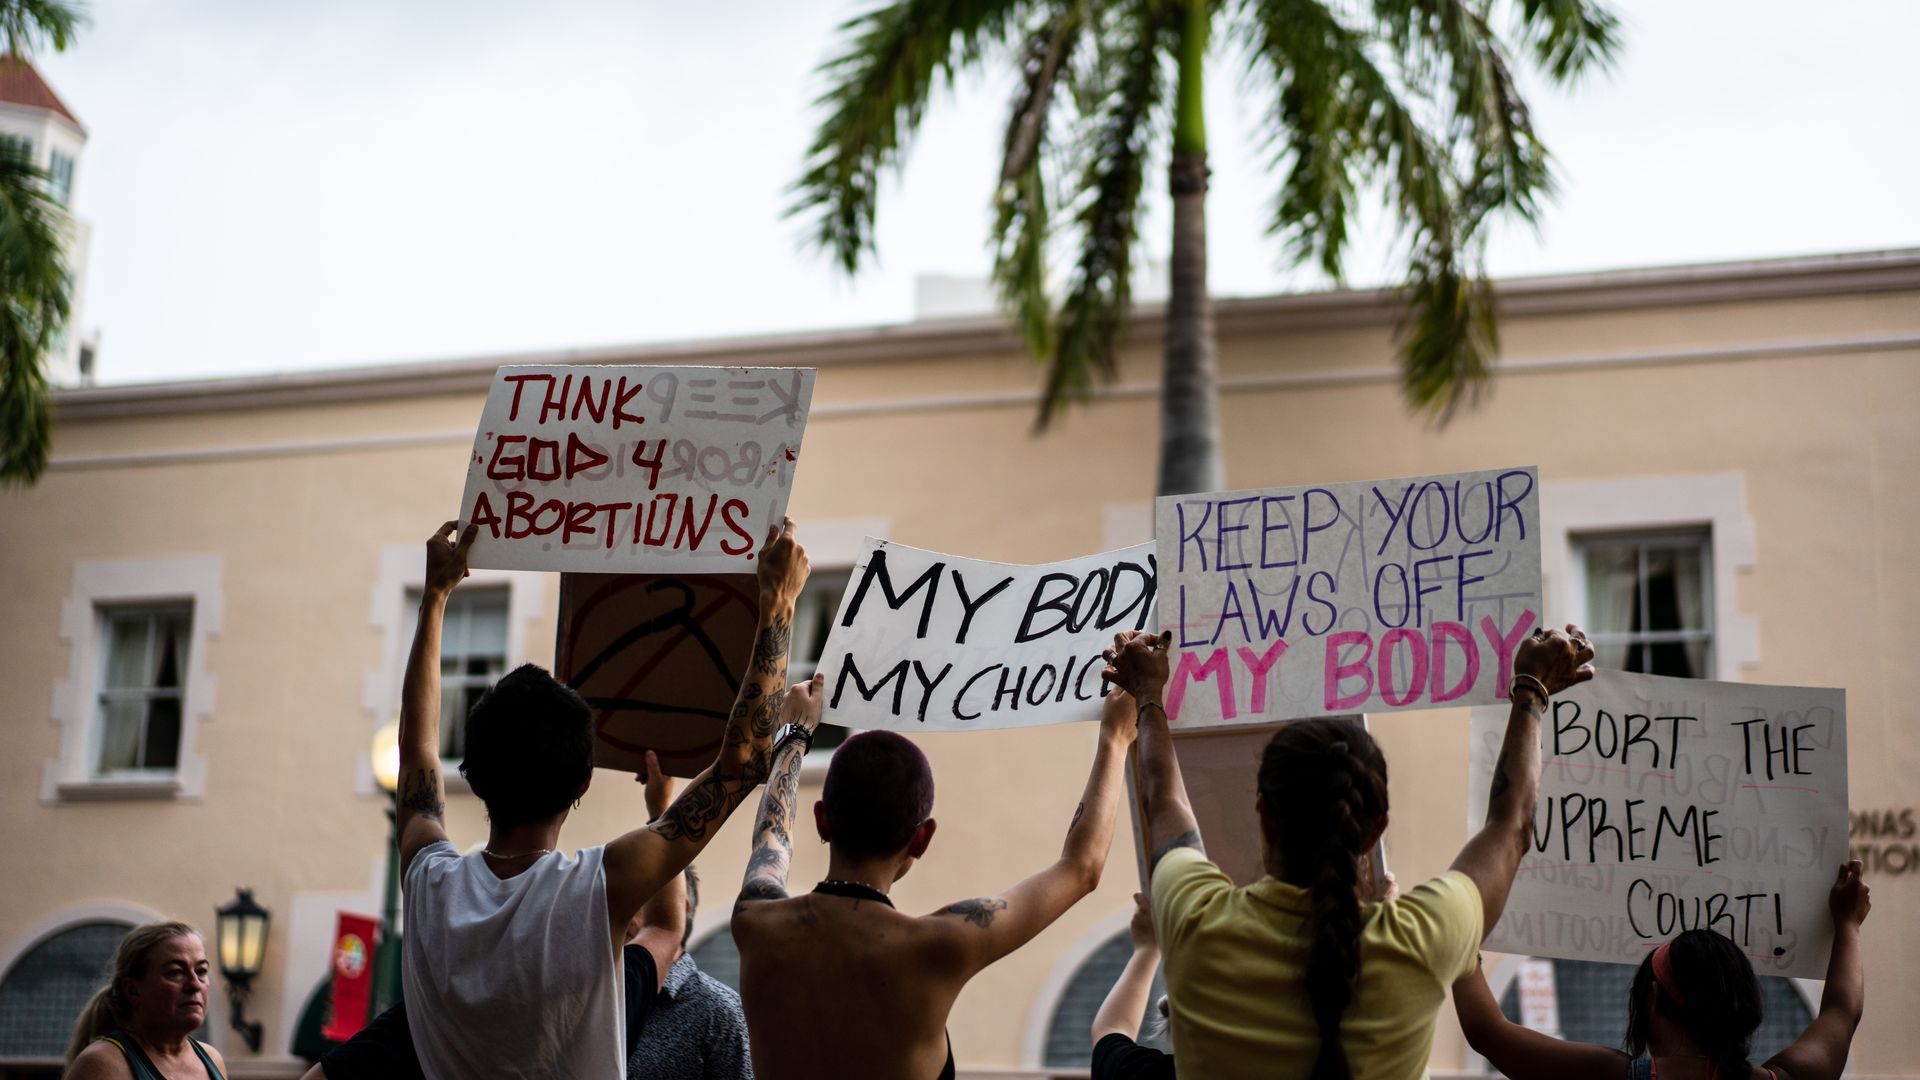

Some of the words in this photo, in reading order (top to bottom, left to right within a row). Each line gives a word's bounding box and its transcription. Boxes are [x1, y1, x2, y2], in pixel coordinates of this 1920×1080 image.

[504, 374, 645, 430] THNK
[486, 432, 608, 482] GOD
[632, 438, 667, 490] 4
[1176, 488, 1341, 573] KEEP
[1371, 470, 1534, 557] YOUR
[841, 550, 1015, 645] MY
[1179, 574, 1337, 649] LAWS
[1373, 549, 1494, 629] OFF
[829, 652, 953, 722] MY
[1165, 638, 1289, 721] MY
[1324, 609, 1537, 711] BODY
[1541, 699, 1698, 769] BORT
[1730, 718, 1816, 781] THE
[1533, 792, 1723, 868] UPREME
